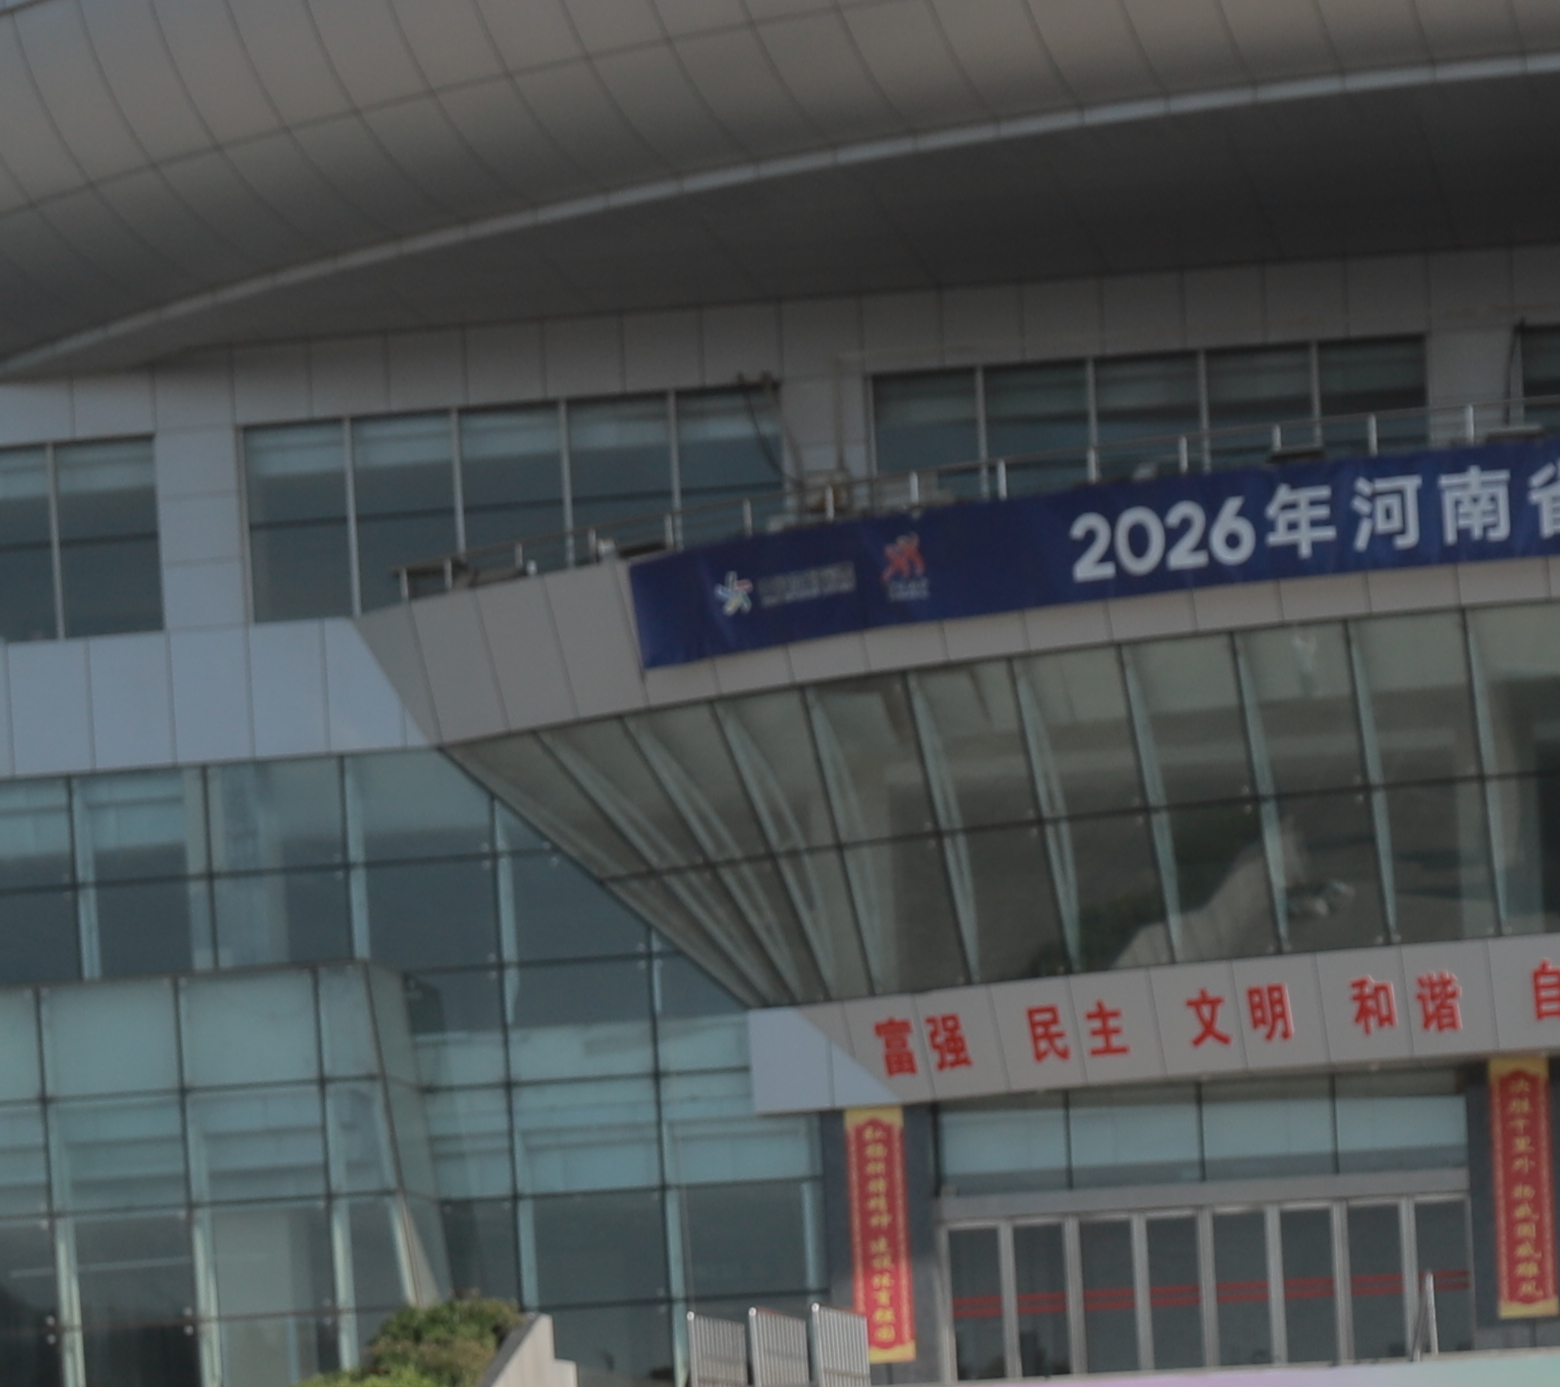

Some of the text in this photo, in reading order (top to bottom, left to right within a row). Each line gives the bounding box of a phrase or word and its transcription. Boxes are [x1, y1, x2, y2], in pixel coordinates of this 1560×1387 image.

[875, 1013, 972, 1076] 富强
[1027, 1002, 1129, 1063] 民主
[1186, 983, 1292, 1047] 文明
[1351, 972, 1461, 1033] 和谐
